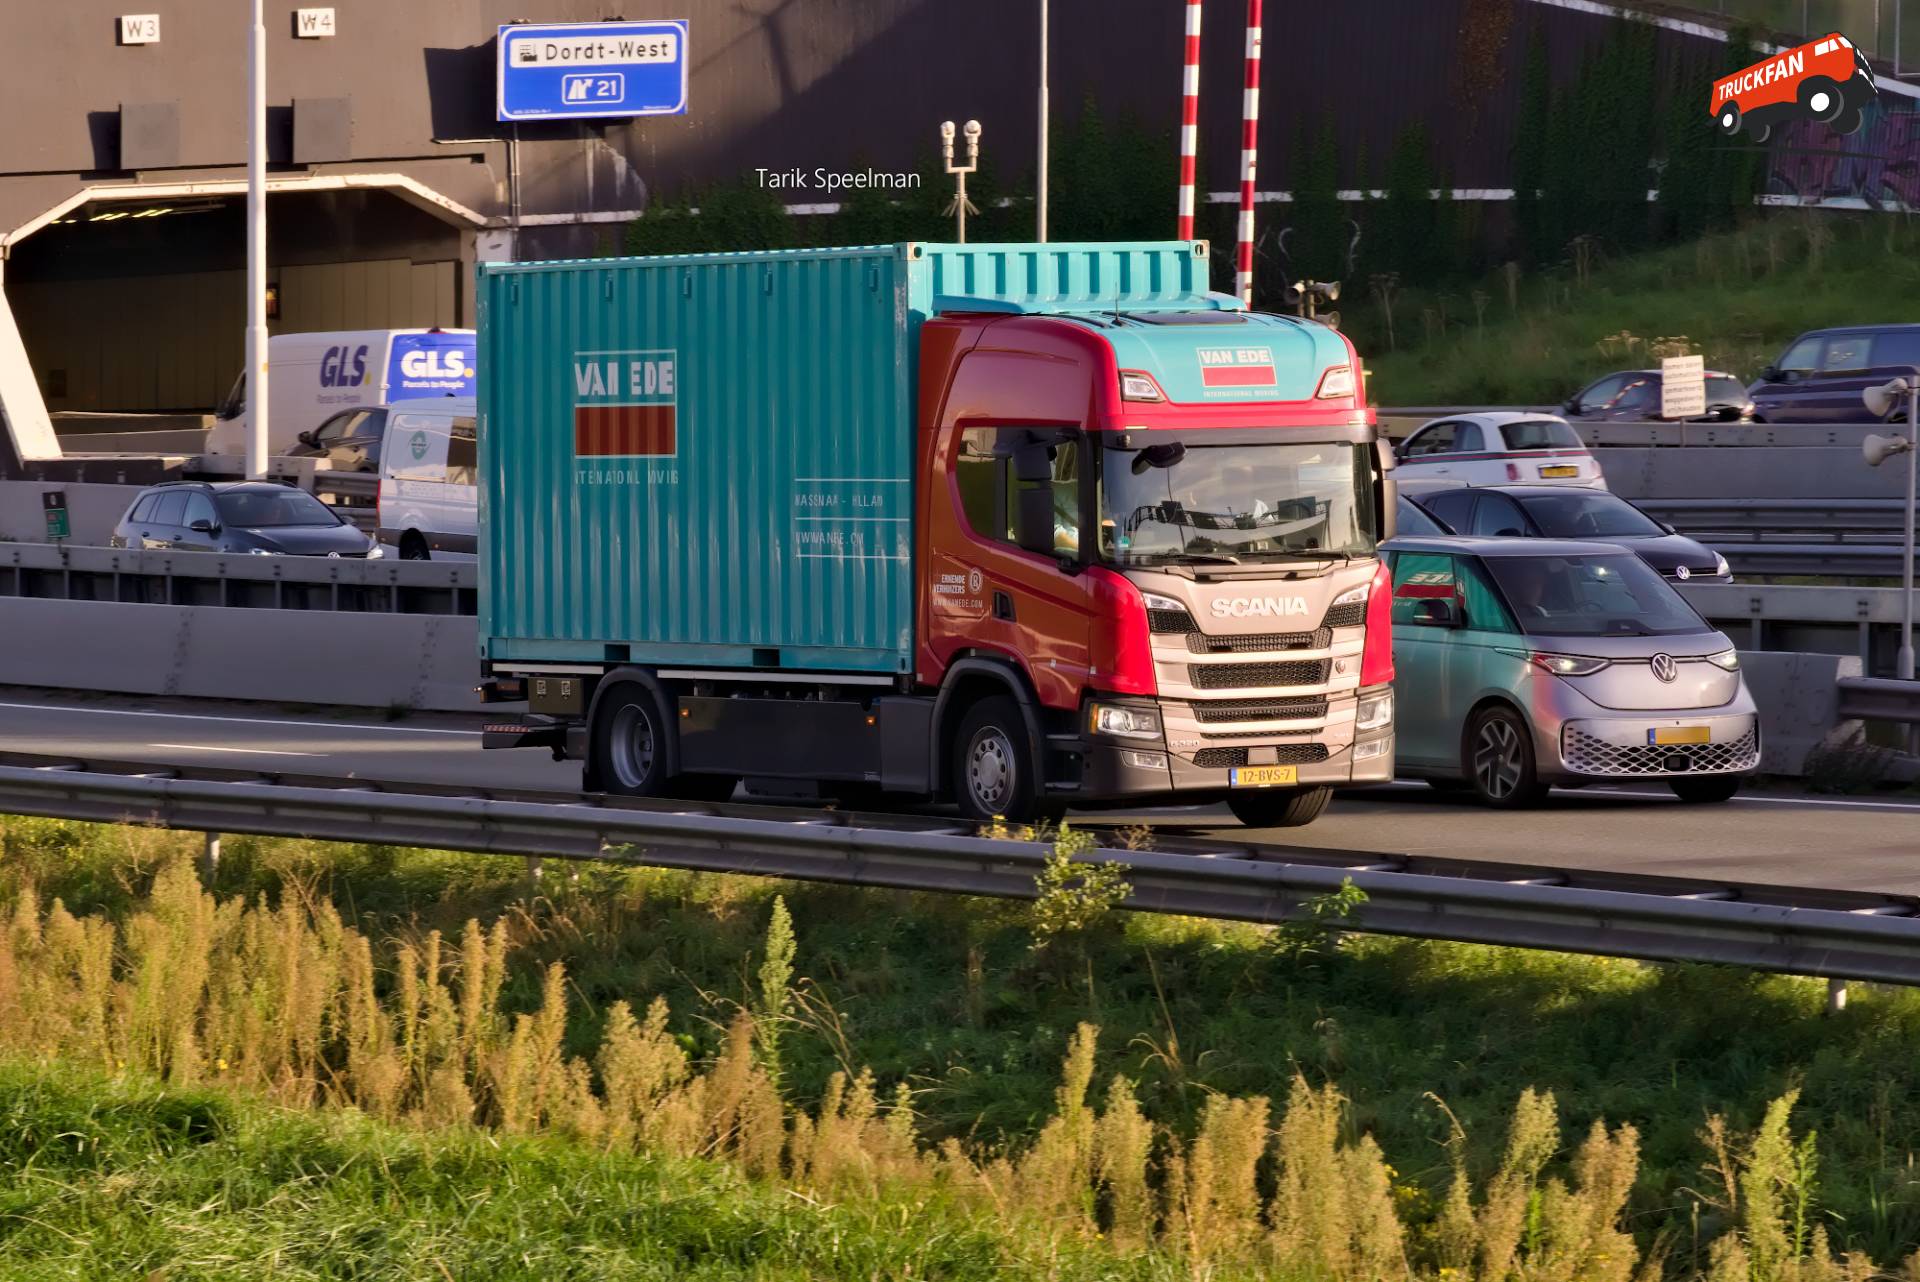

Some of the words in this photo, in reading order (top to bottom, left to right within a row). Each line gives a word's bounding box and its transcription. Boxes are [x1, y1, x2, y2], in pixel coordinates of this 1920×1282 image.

[545, 40, 669, 60] Dordt-West
[597, 80, 617, 97] 21
[1200, 350, 1233, 364] VAN
[1237, 349, 1271, 363] EDE
[630, 361, 673, 395] EDE
[1211, 597, 1309, 618] SCANIA
[1243, 768, 1291, 783] 12-BVS-7
